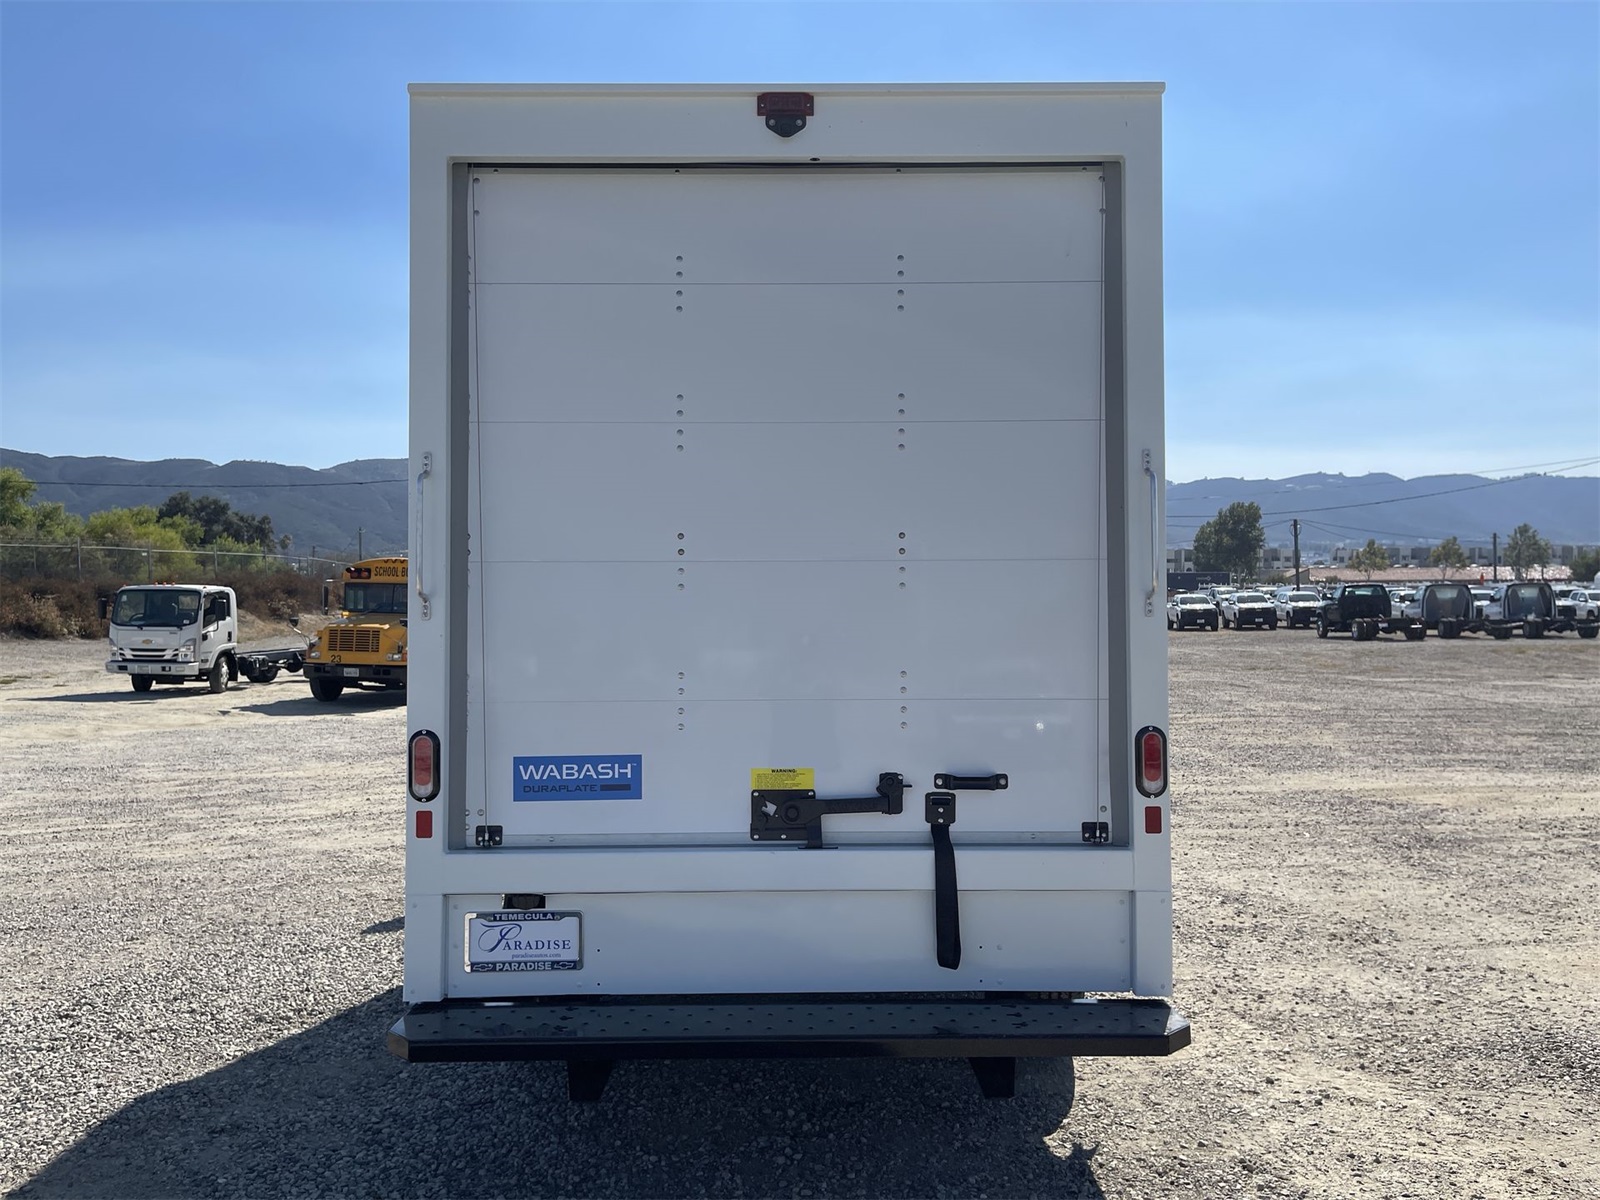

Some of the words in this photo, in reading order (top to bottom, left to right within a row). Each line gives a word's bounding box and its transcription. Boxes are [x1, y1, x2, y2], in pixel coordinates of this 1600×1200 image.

[374, 566, 399, 577] SCHOOL
[330, 654, 342, 663] 23
[519, 763, 632, 780] WABASH
[523, 784, 597, 793] DURAPLATE
[494, 913, 554, 921] TEMECULA
[495, 962, 552, 972] PARADISE
